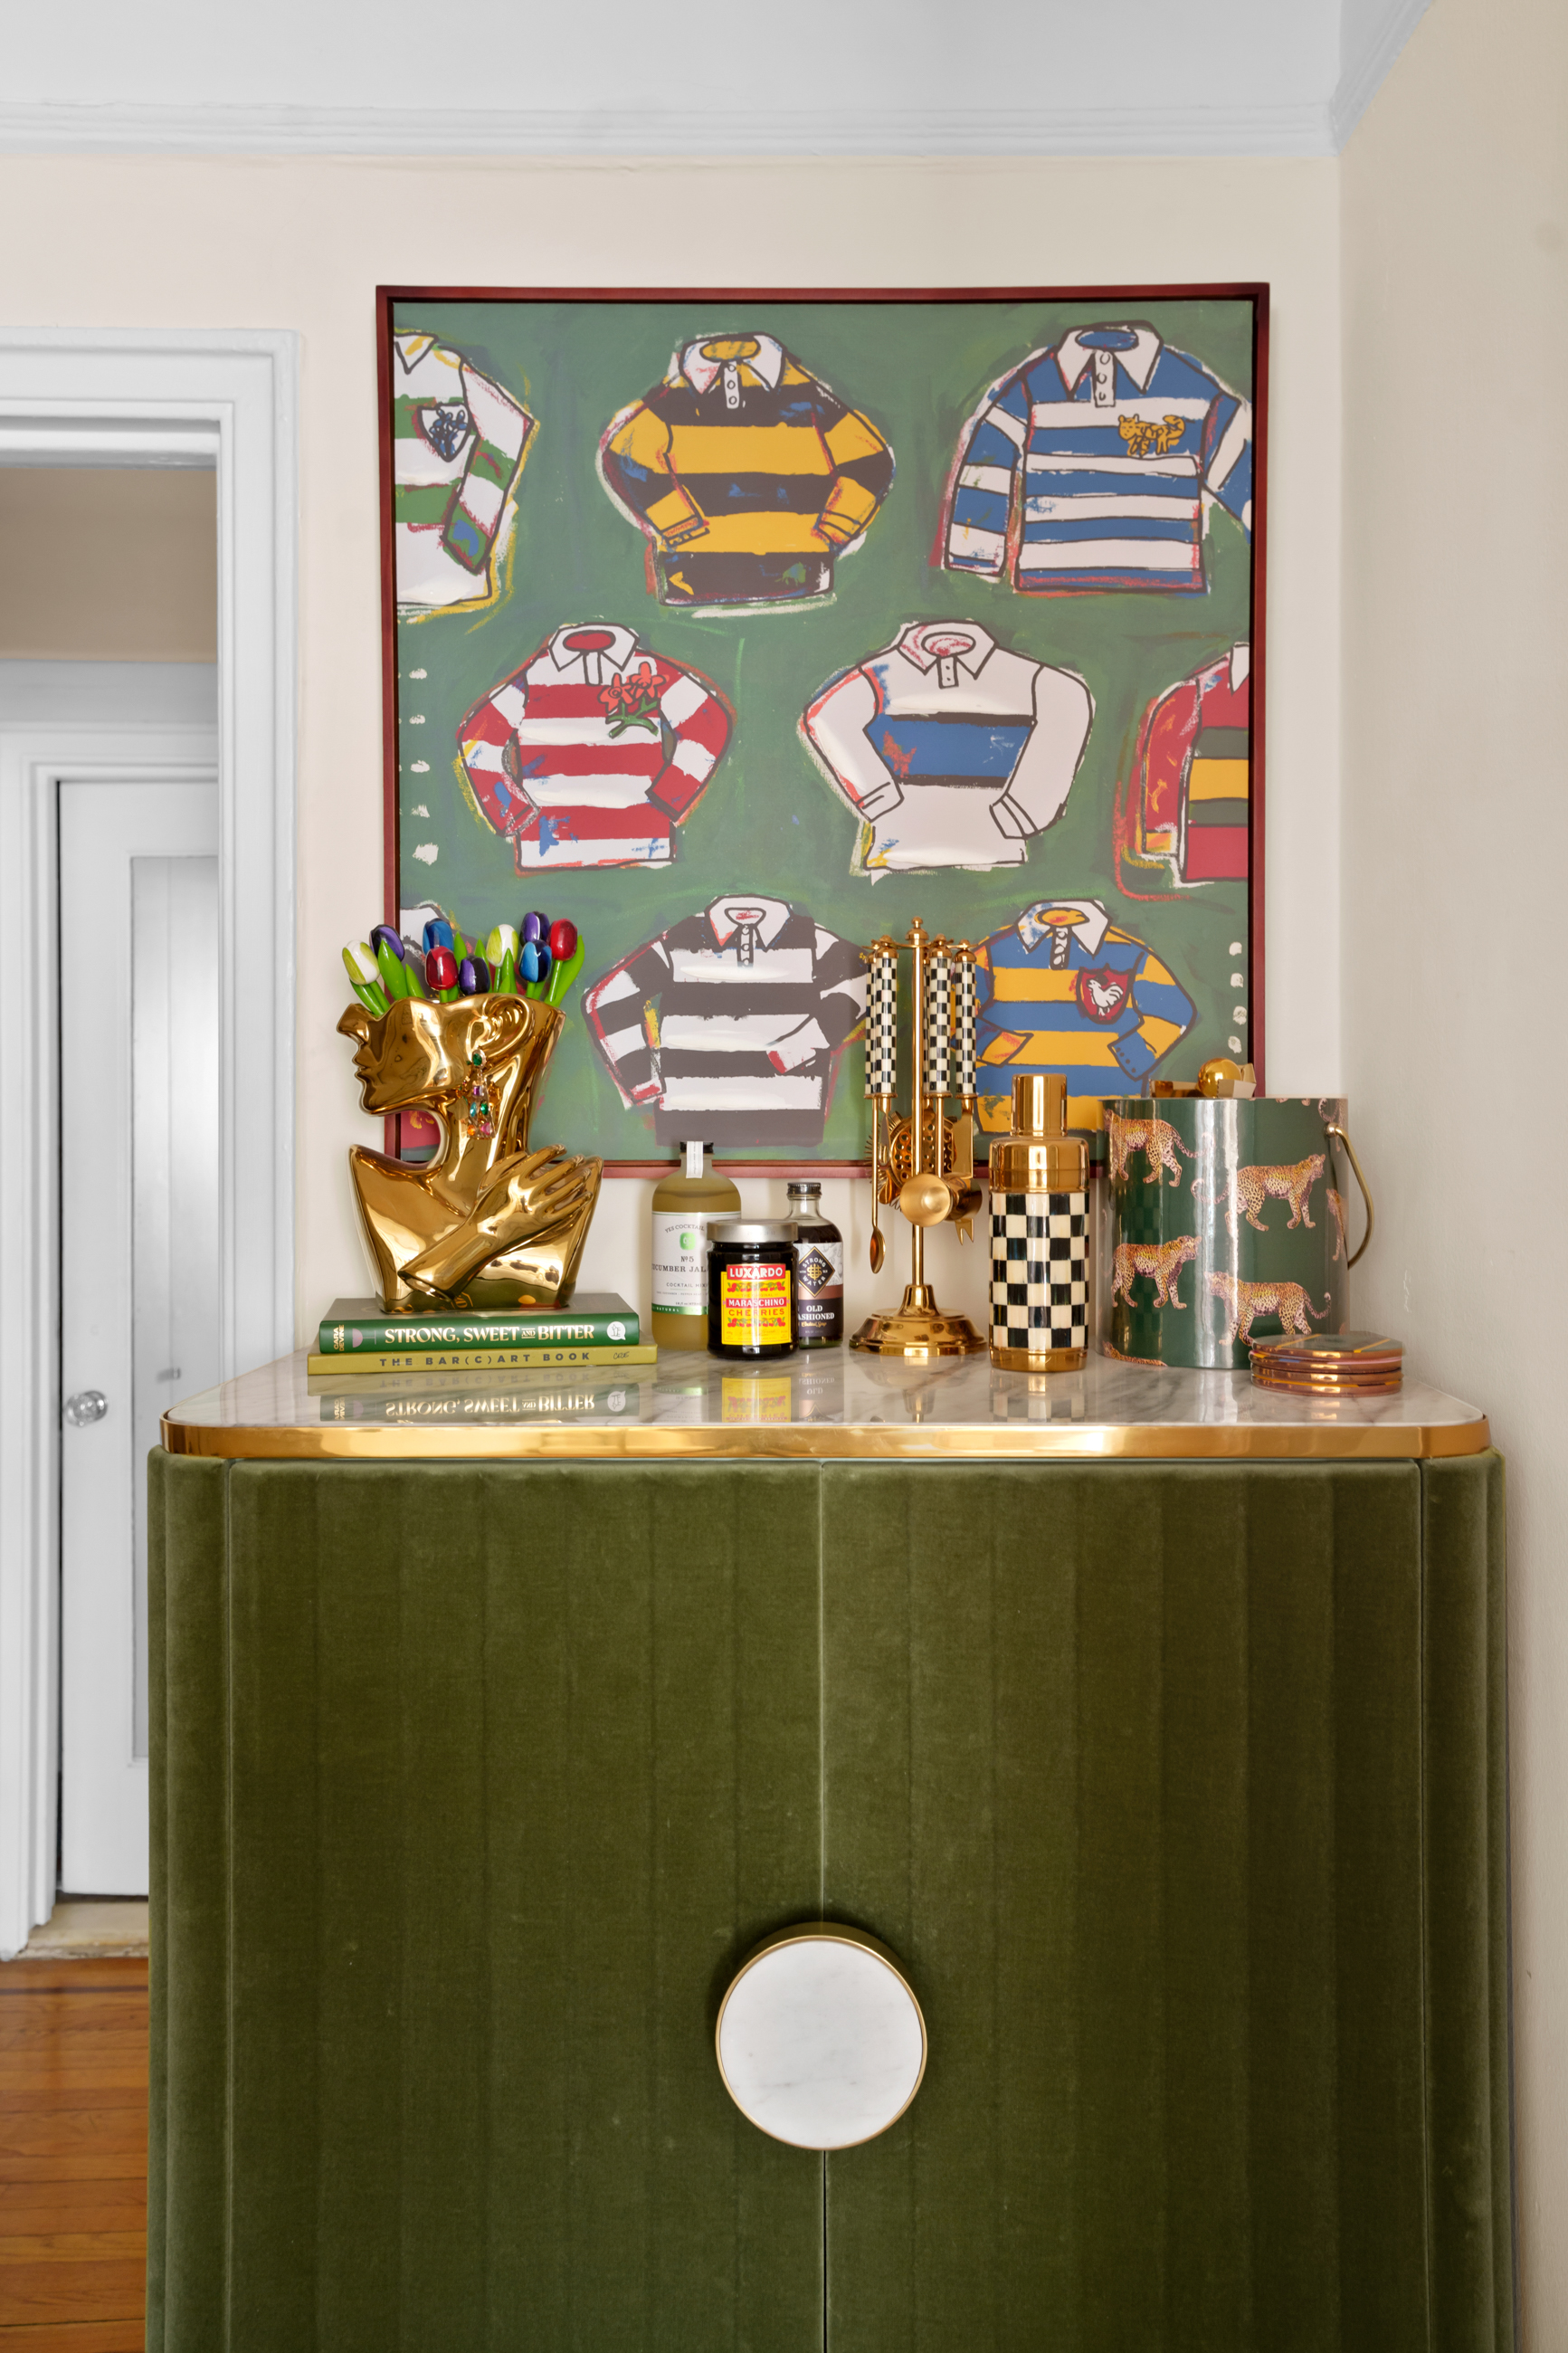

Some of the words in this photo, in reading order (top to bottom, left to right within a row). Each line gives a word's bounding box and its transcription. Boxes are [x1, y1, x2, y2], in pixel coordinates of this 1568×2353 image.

[665, 1225, 675, 1234] YES
[675, 1224, 705, 1232] COCKTAIL
[802, 1257, 827, 1268] STRONG
[729, 1267, 784, 1279] LUXARDO
[803, 1275, 826, 1286] WATER
[728, 1298, 784, 1307] MARASCHINO
[385, 1327, 460, 1344] STRONG,
[463, 1326, 519, 1342] SWEET
[521, 1329, 536, 1338] AND
[537, 1324, 595, 1340] BITTER
[379, 1358, 413, 1367] THE
[543, 1352, 590, 1361] BOOK
